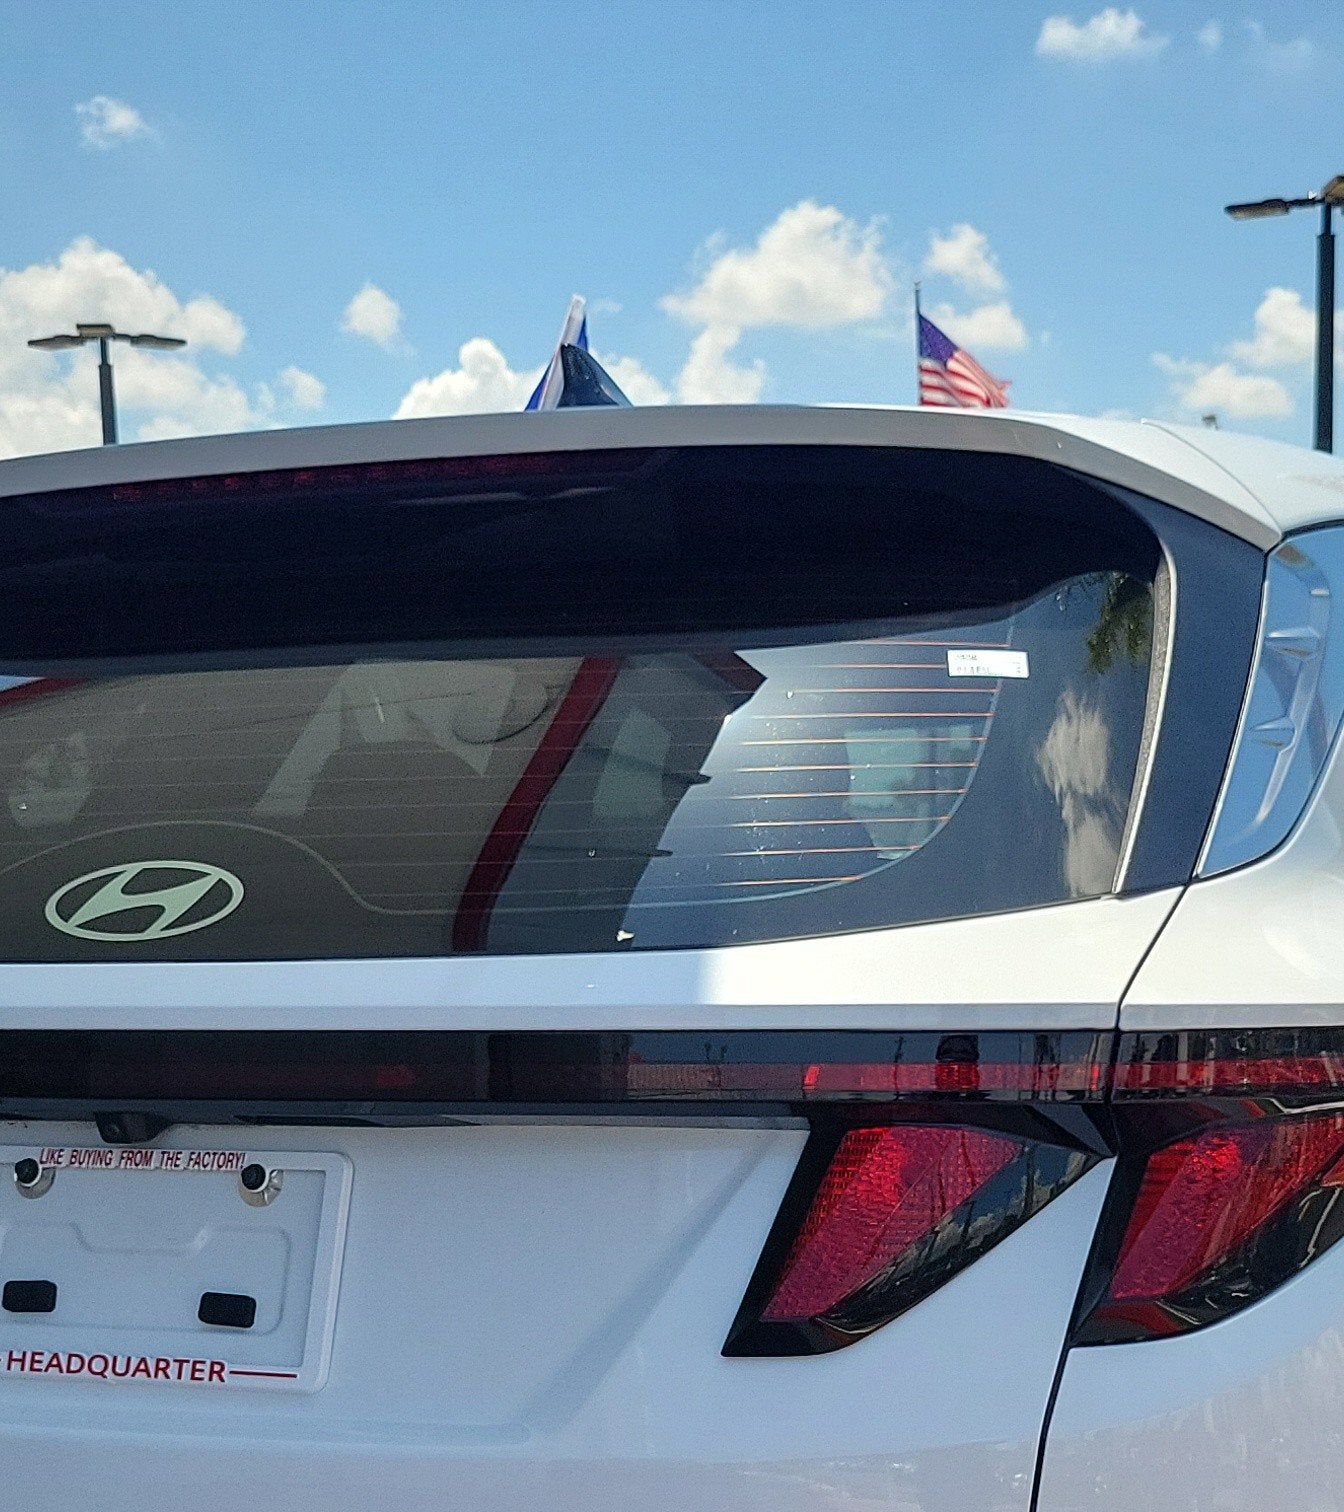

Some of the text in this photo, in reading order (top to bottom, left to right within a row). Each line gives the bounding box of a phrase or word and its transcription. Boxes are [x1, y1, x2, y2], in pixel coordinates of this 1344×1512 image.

[39, 1148, 246, 1169] LIKE BUYING FROM THE FACTORY!
[6, 1350, 227, 1383] HEADQUARTER
